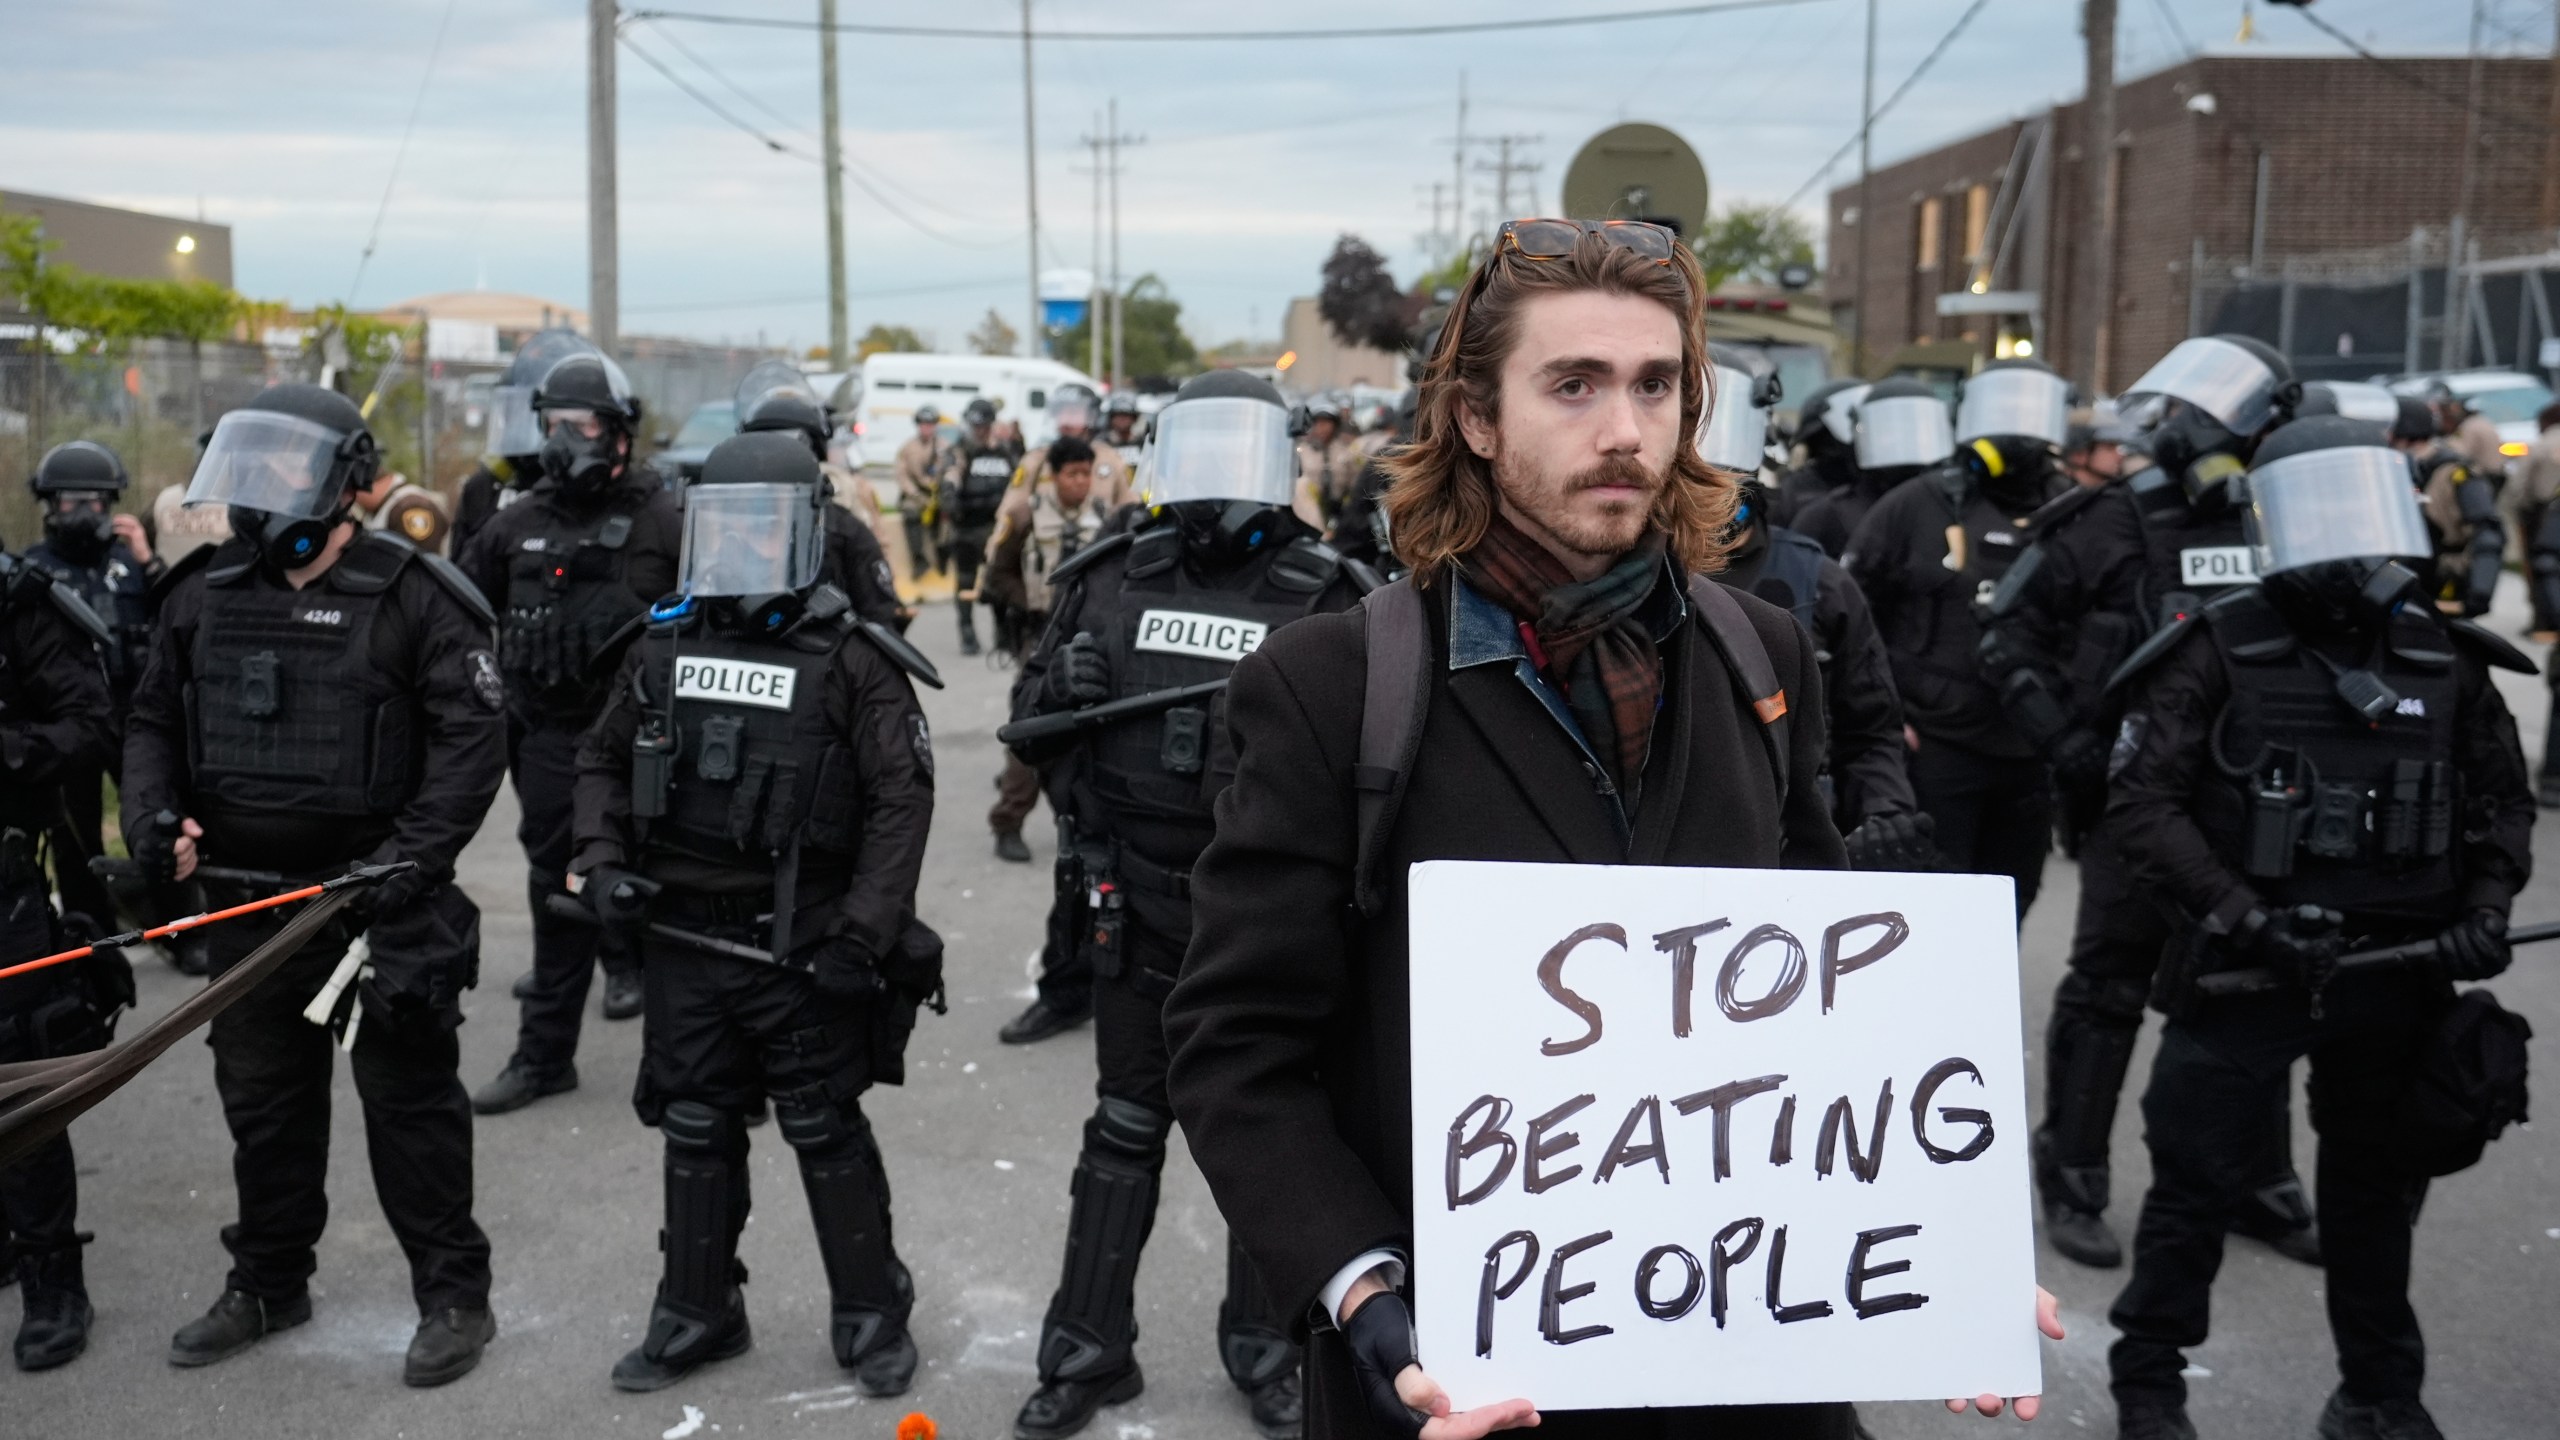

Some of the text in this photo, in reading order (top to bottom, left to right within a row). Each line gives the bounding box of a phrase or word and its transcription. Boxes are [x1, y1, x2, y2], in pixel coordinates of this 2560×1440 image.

[304, 610, 342, 625] 4240
[1144, 617, 1257, 653] POLICE
[677, 665, 786, 699] POLICE
[1537, 912, 1909, 1056] STOP
[1446, 1057, 1994, 1211] BEATING
[1476, 1217, 1929, 1359] PEOPLE
